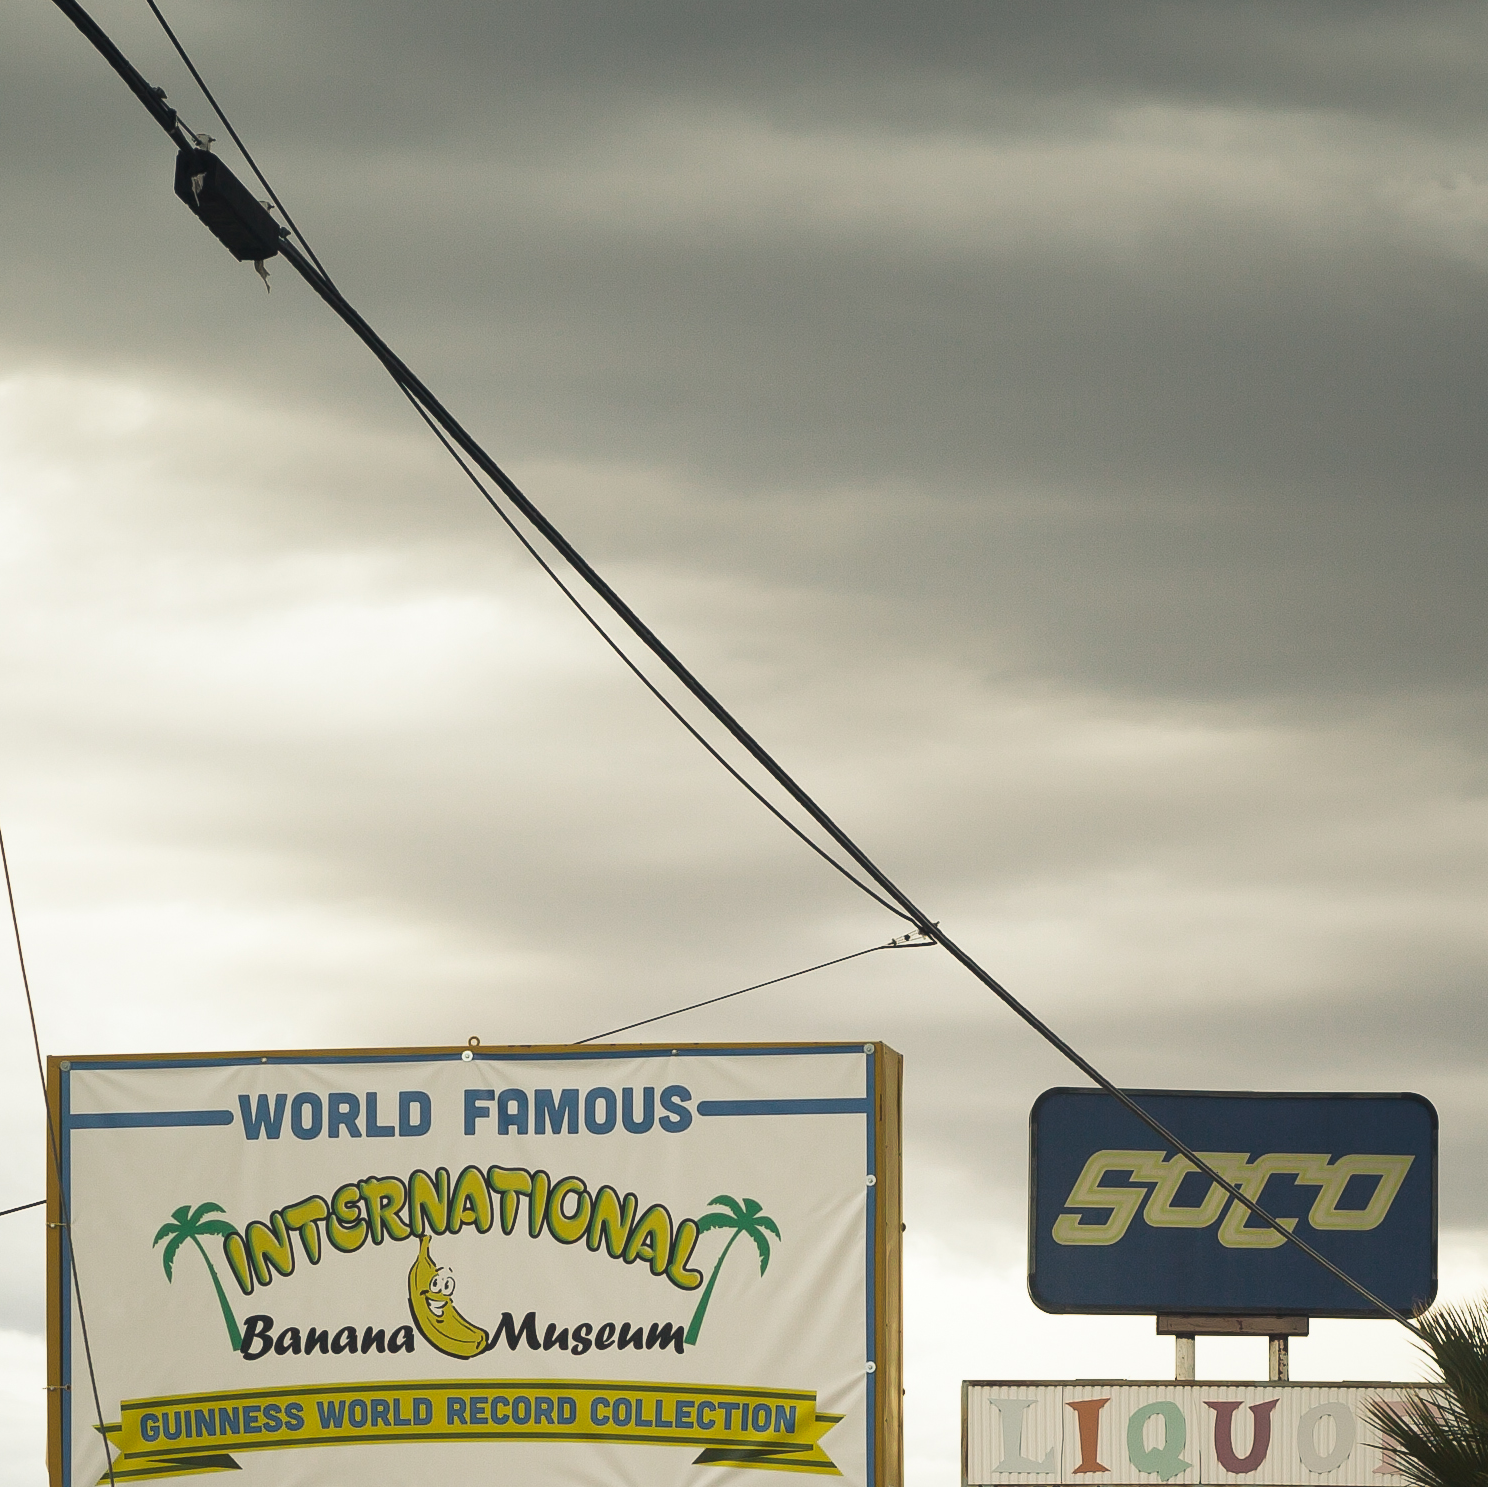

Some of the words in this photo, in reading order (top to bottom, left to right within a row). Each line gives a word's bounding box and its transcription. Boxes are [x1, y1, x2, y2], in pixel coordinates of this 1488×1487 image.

[238, 1090, 432, 1140] WORLD
[463, 1085, 693, 1136] FAMOUS
[1052, 1149, 1416, 1249] SOCO
[223, 1165, 704, 1296] INTERNATIONAL
[240, 1314, 416, 1361] Banana
[486, 1311, 686, 1355] Museum
[139, 1402, 306, 1443] GUINNESS
[317, 1396, 434, 1430] WORLD
[446, 1395, 578, 1426] RECORD
[589, 1395, 799, 1435] COLLECTION
